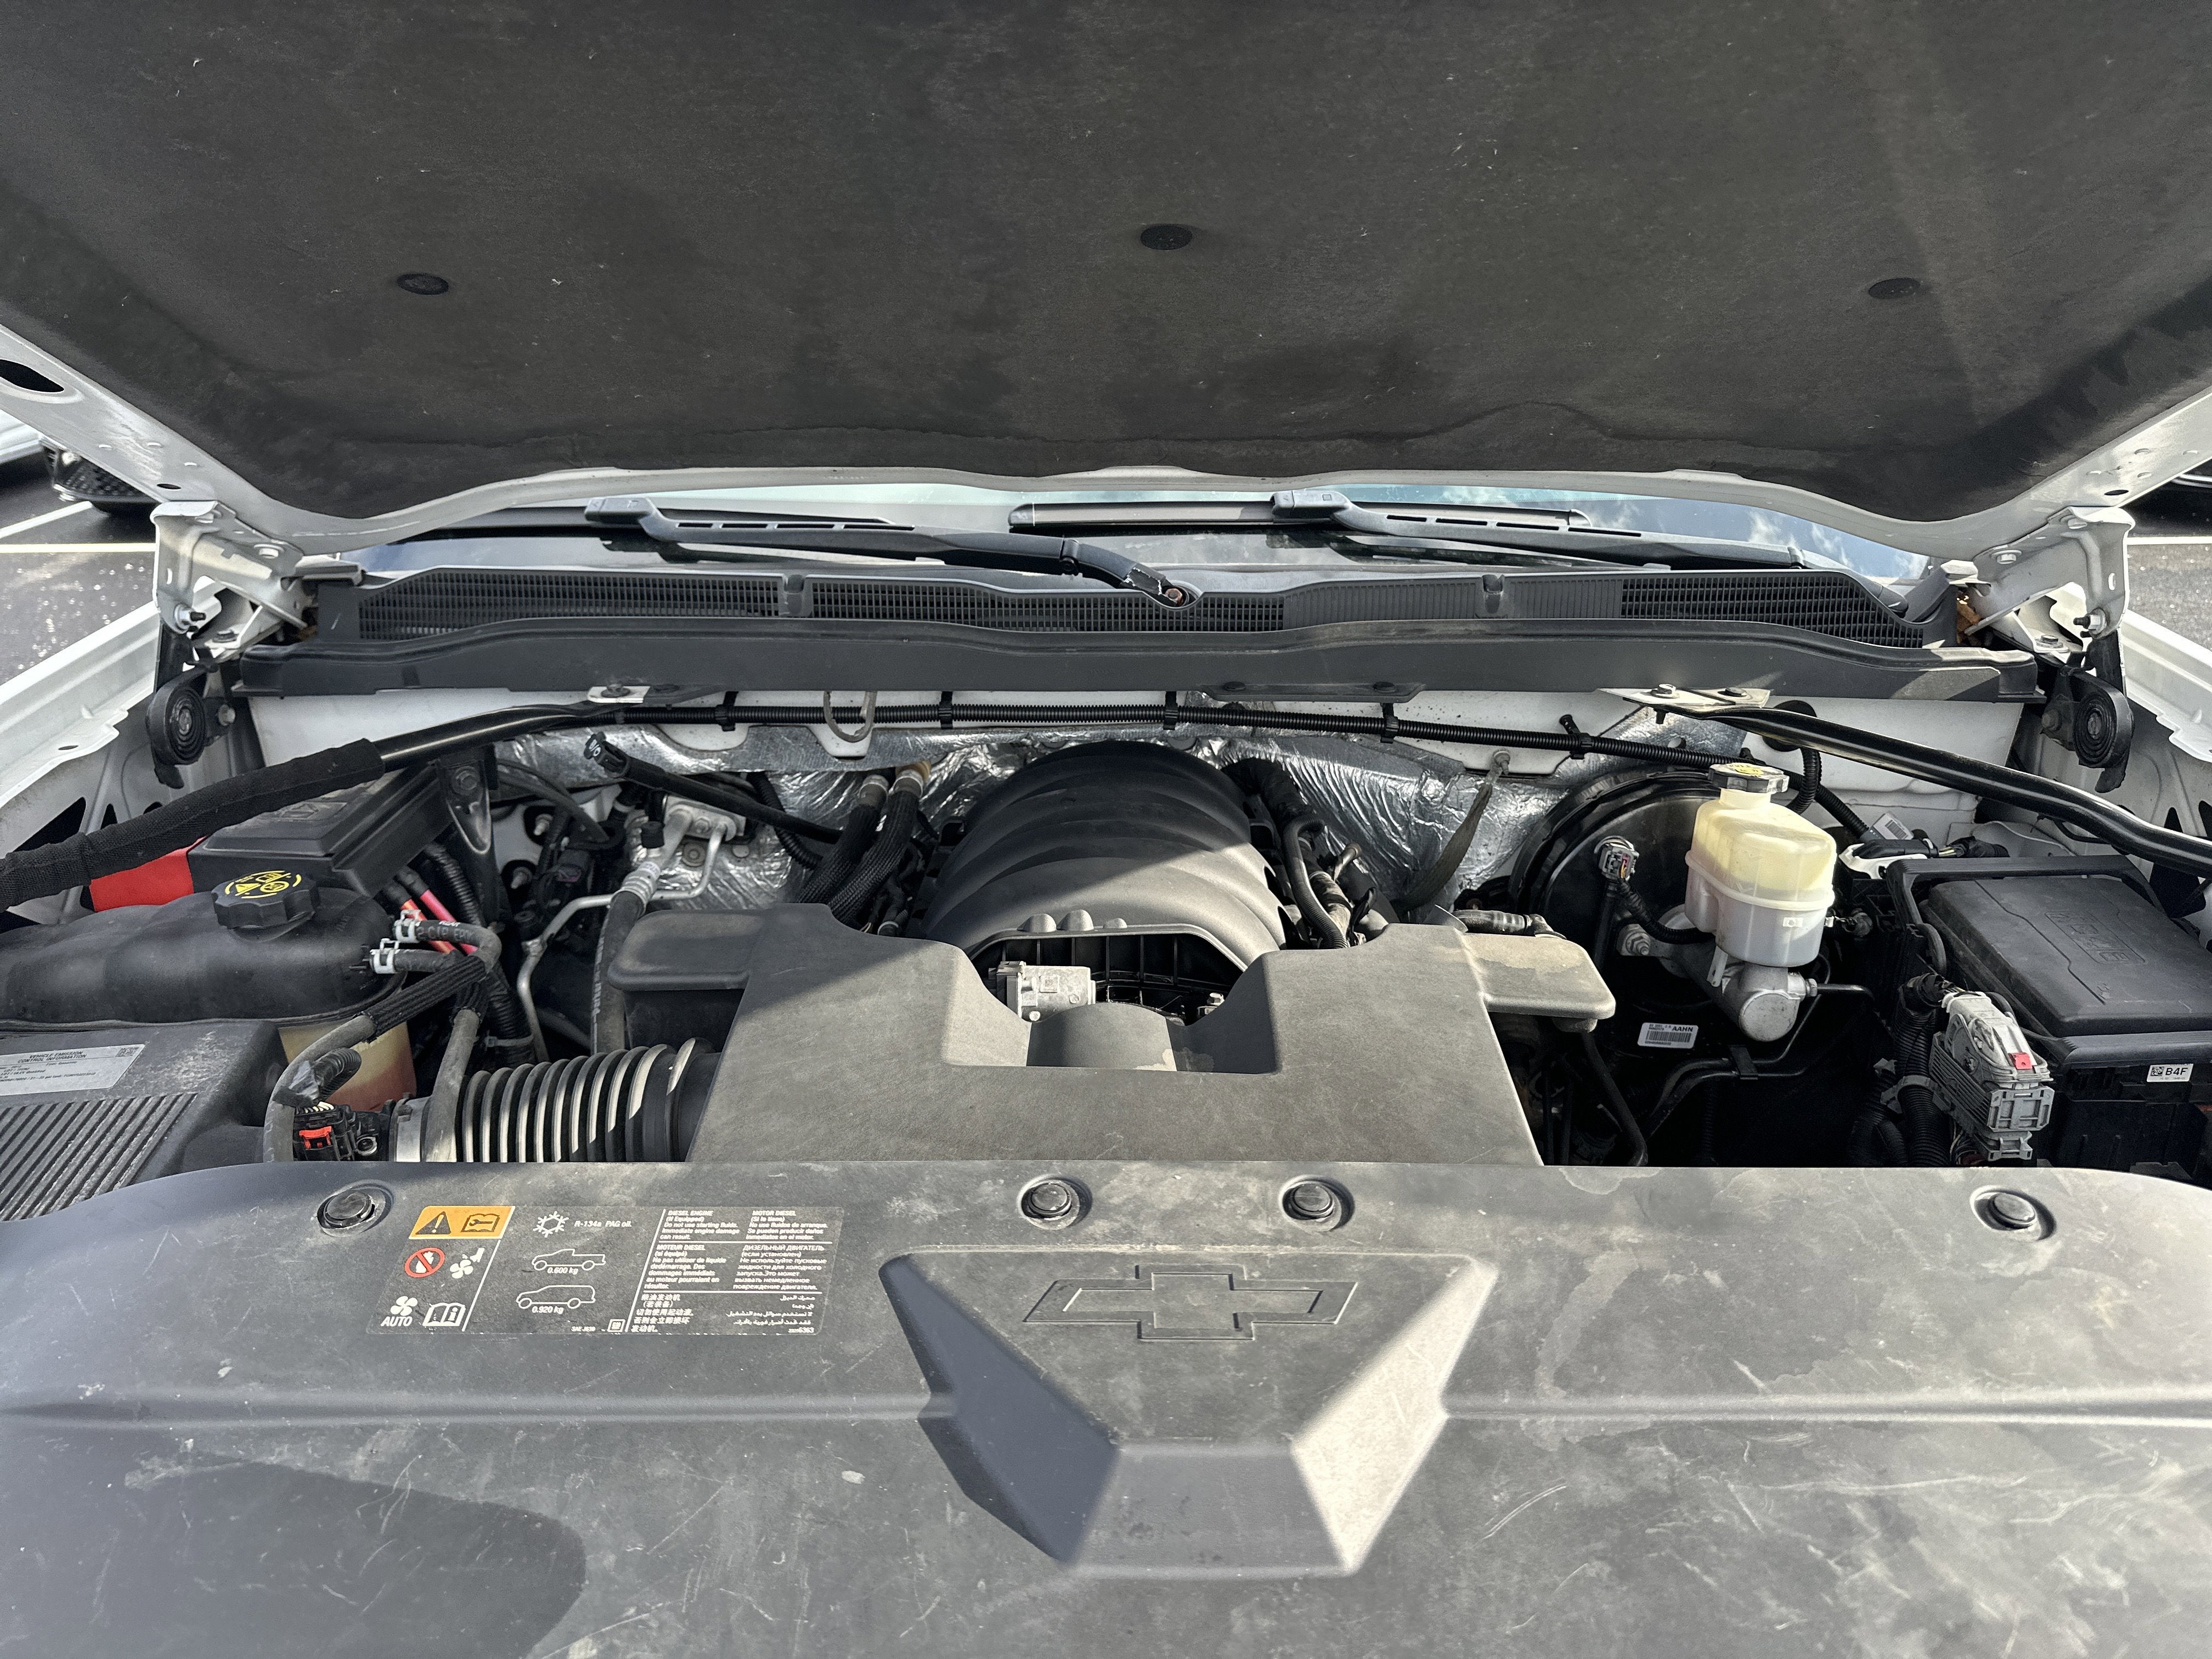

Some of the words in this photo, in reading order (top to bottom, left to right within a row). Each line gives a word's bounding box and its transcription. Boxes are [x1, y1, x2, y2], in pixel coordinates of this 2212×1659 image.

[569, 1267, 579, 1275] kg
[554, 1306, 564, 1314] kg
[381, 1316, 413, 1327] AUTO
